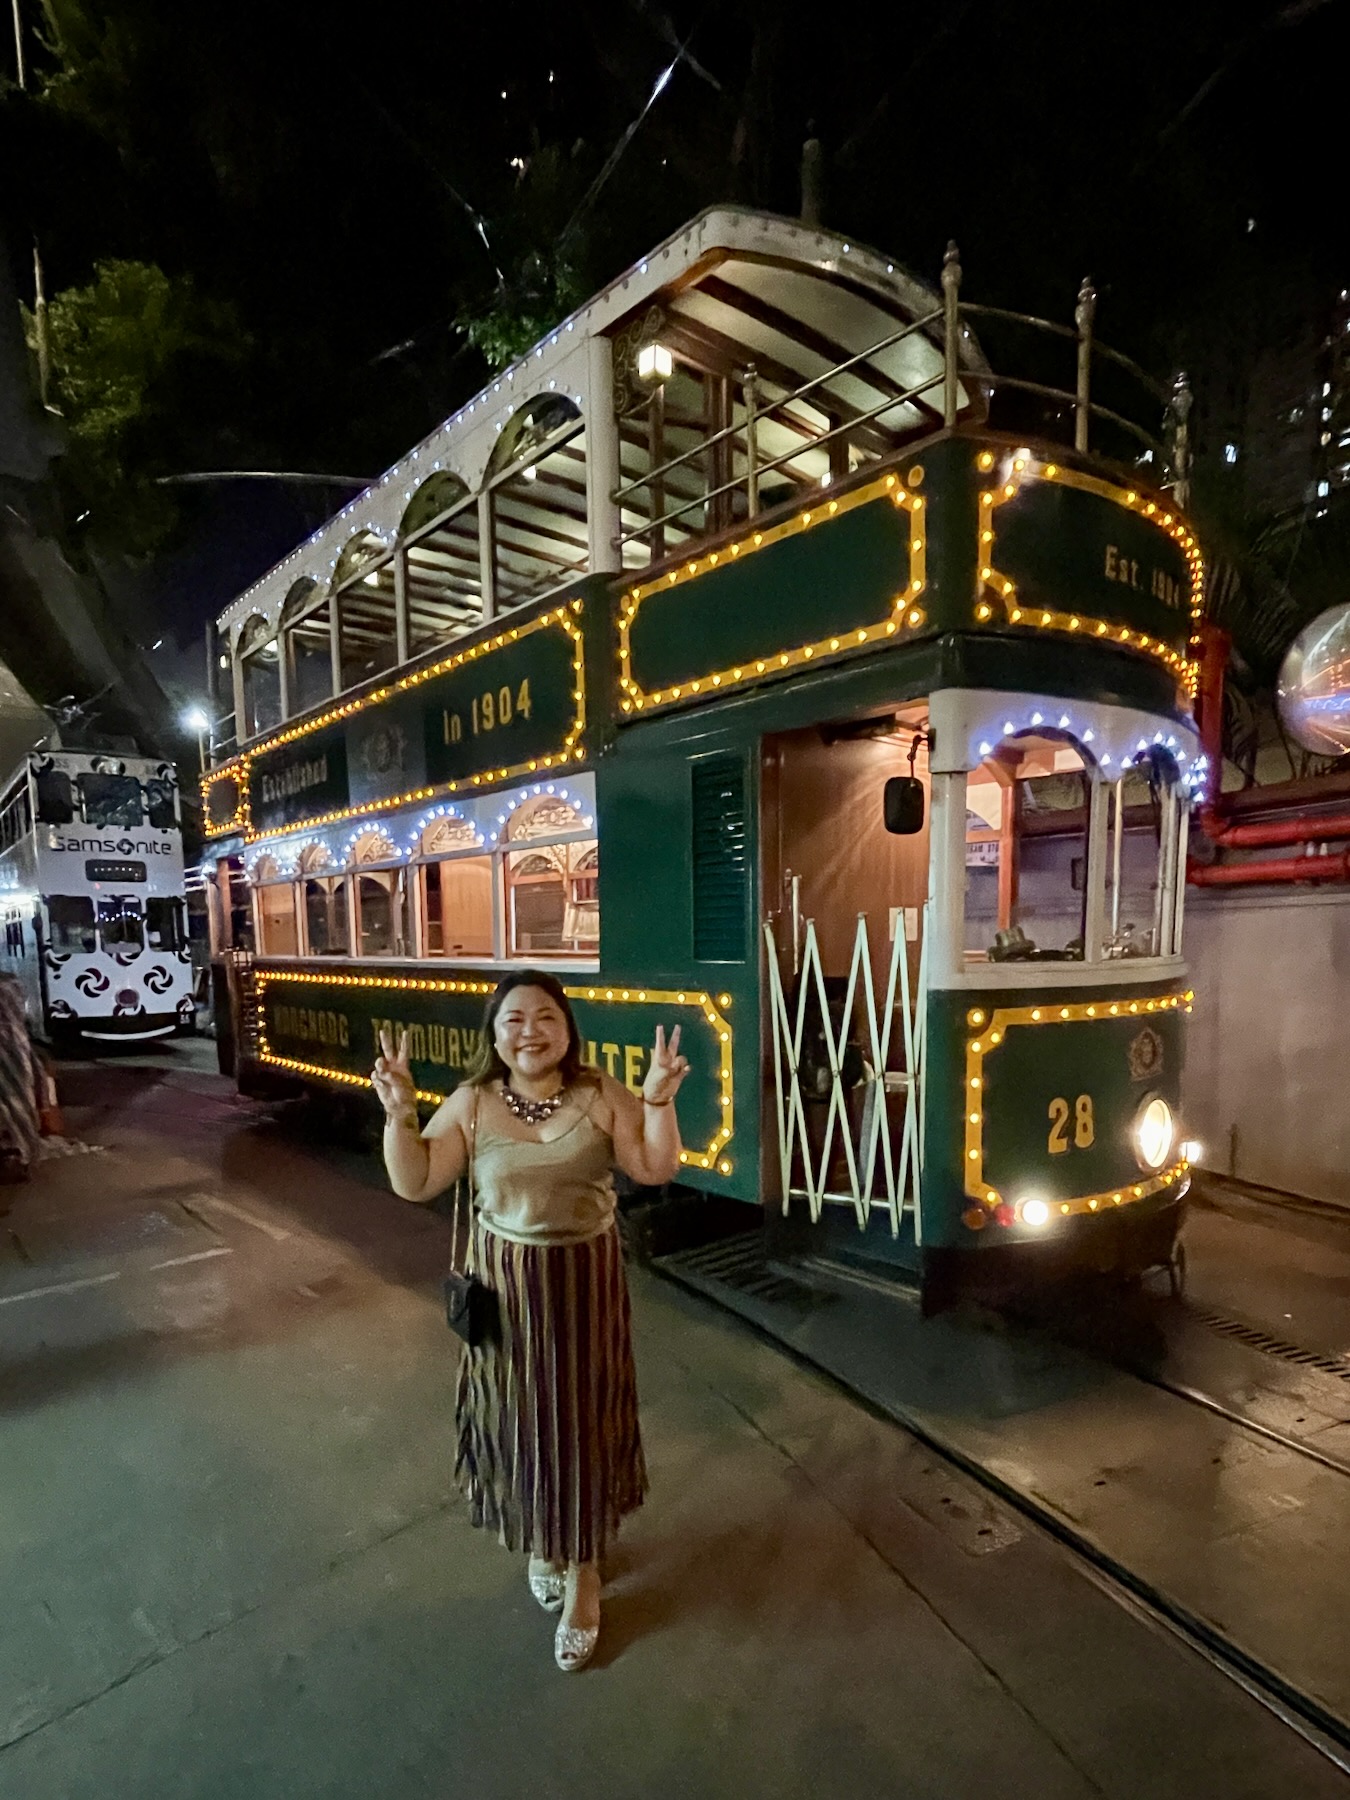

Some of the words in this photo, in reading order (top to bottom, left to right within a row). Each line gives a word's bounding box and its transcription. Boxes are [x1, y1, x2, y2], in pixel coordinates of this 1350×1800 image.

[443, 708, 461, 745] In
[472, 678, 532, 735] 1904
[50, 837, 171, 855] Samsonite
[1048, 1094, 1094, 1154] 28
